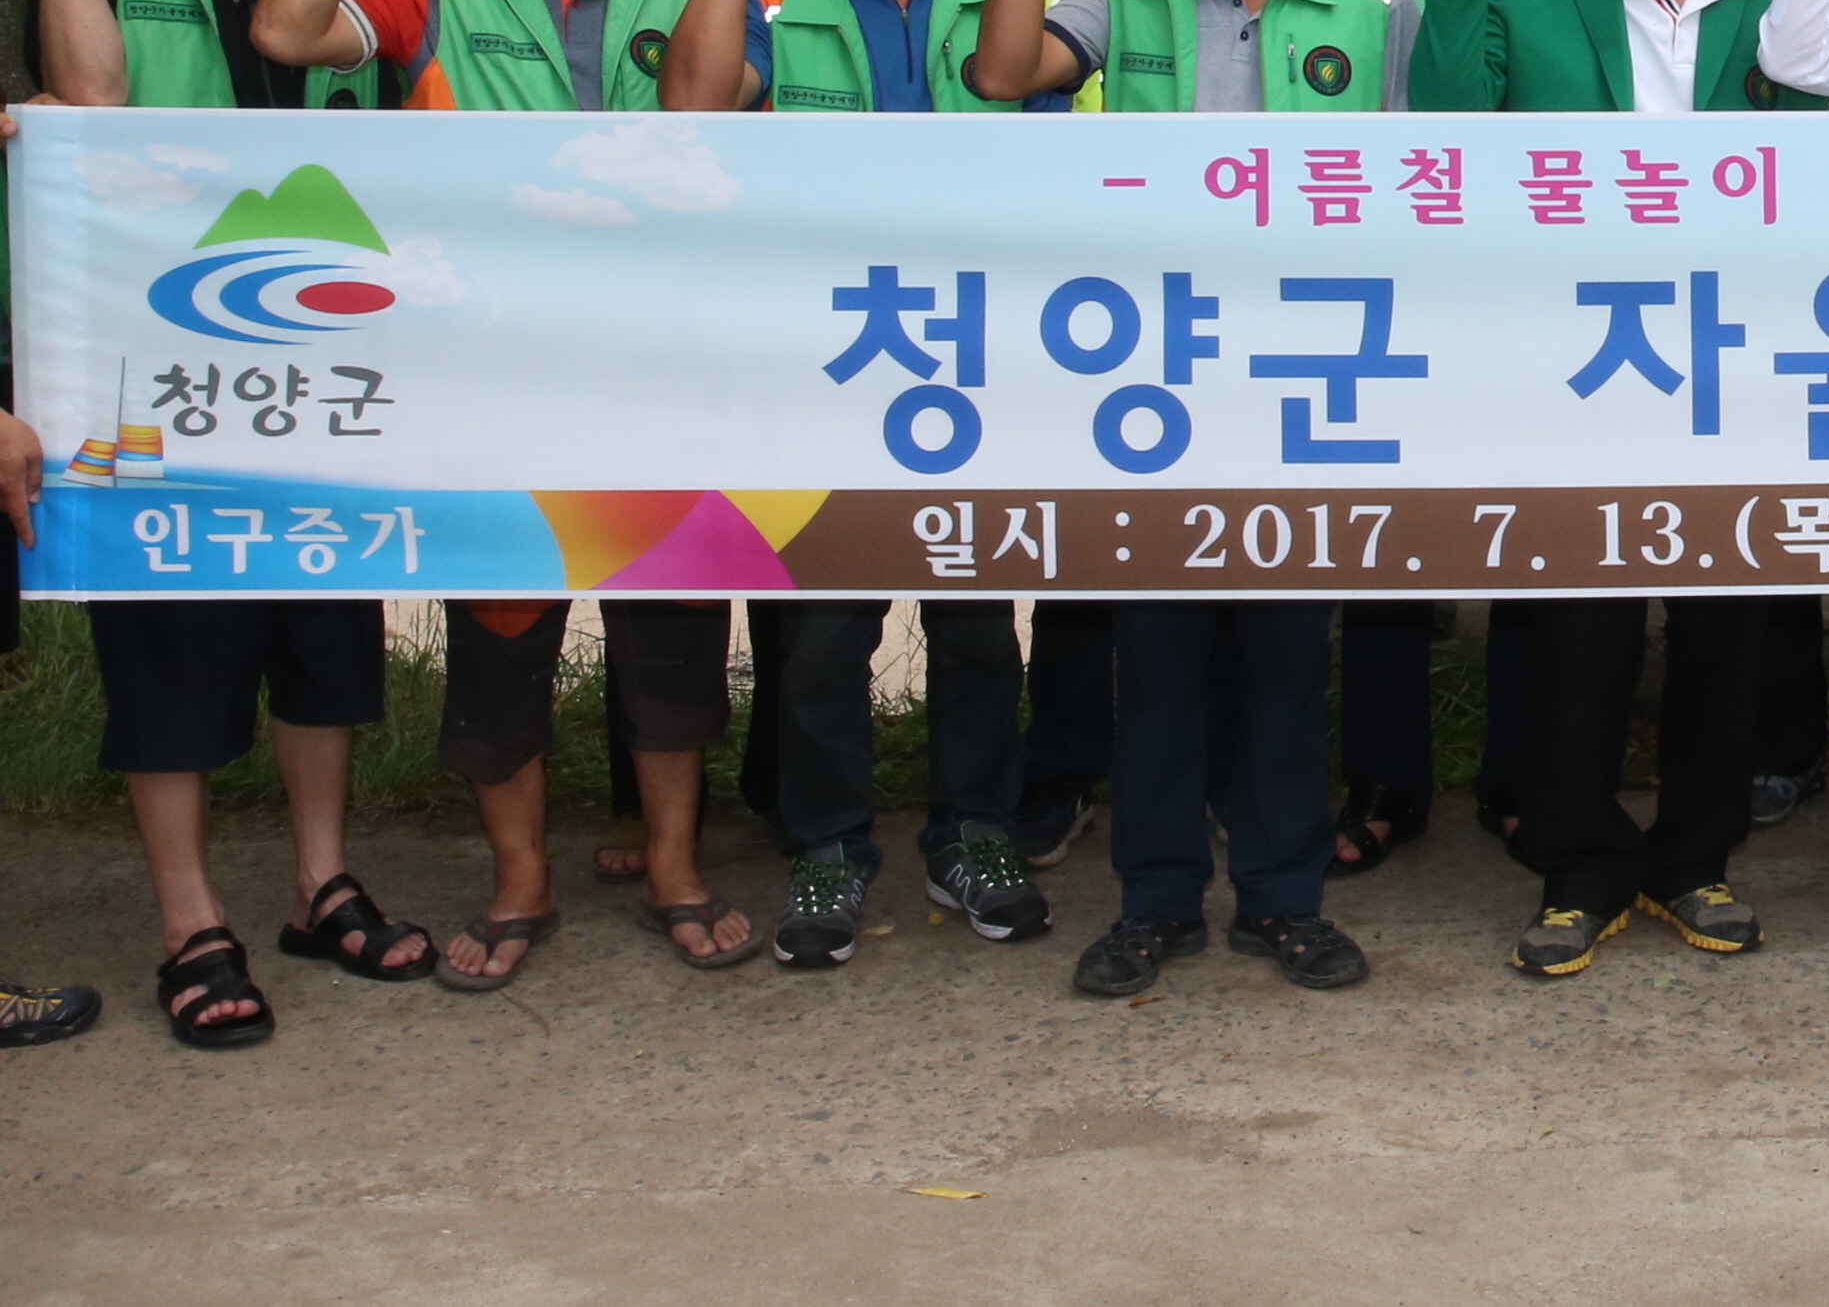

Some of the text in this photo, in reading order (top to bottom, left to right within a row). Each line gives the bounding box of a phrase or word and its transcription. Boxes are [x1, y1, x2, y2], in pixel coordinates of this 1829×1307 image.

[1204, 147, 1465, 227] 여름철
[1520, 147, 1778, 225] 물놀이
[151, 363, 396, 438] 청양군
[823, 265, 1428, 475] 청양군
[132, 503, 427, 576] 인구증가
[911, 500, 1058, 581] 일시
[1182, 502, 1423, 573] 2017.
[1472, 503, 1547, 572] 7.
